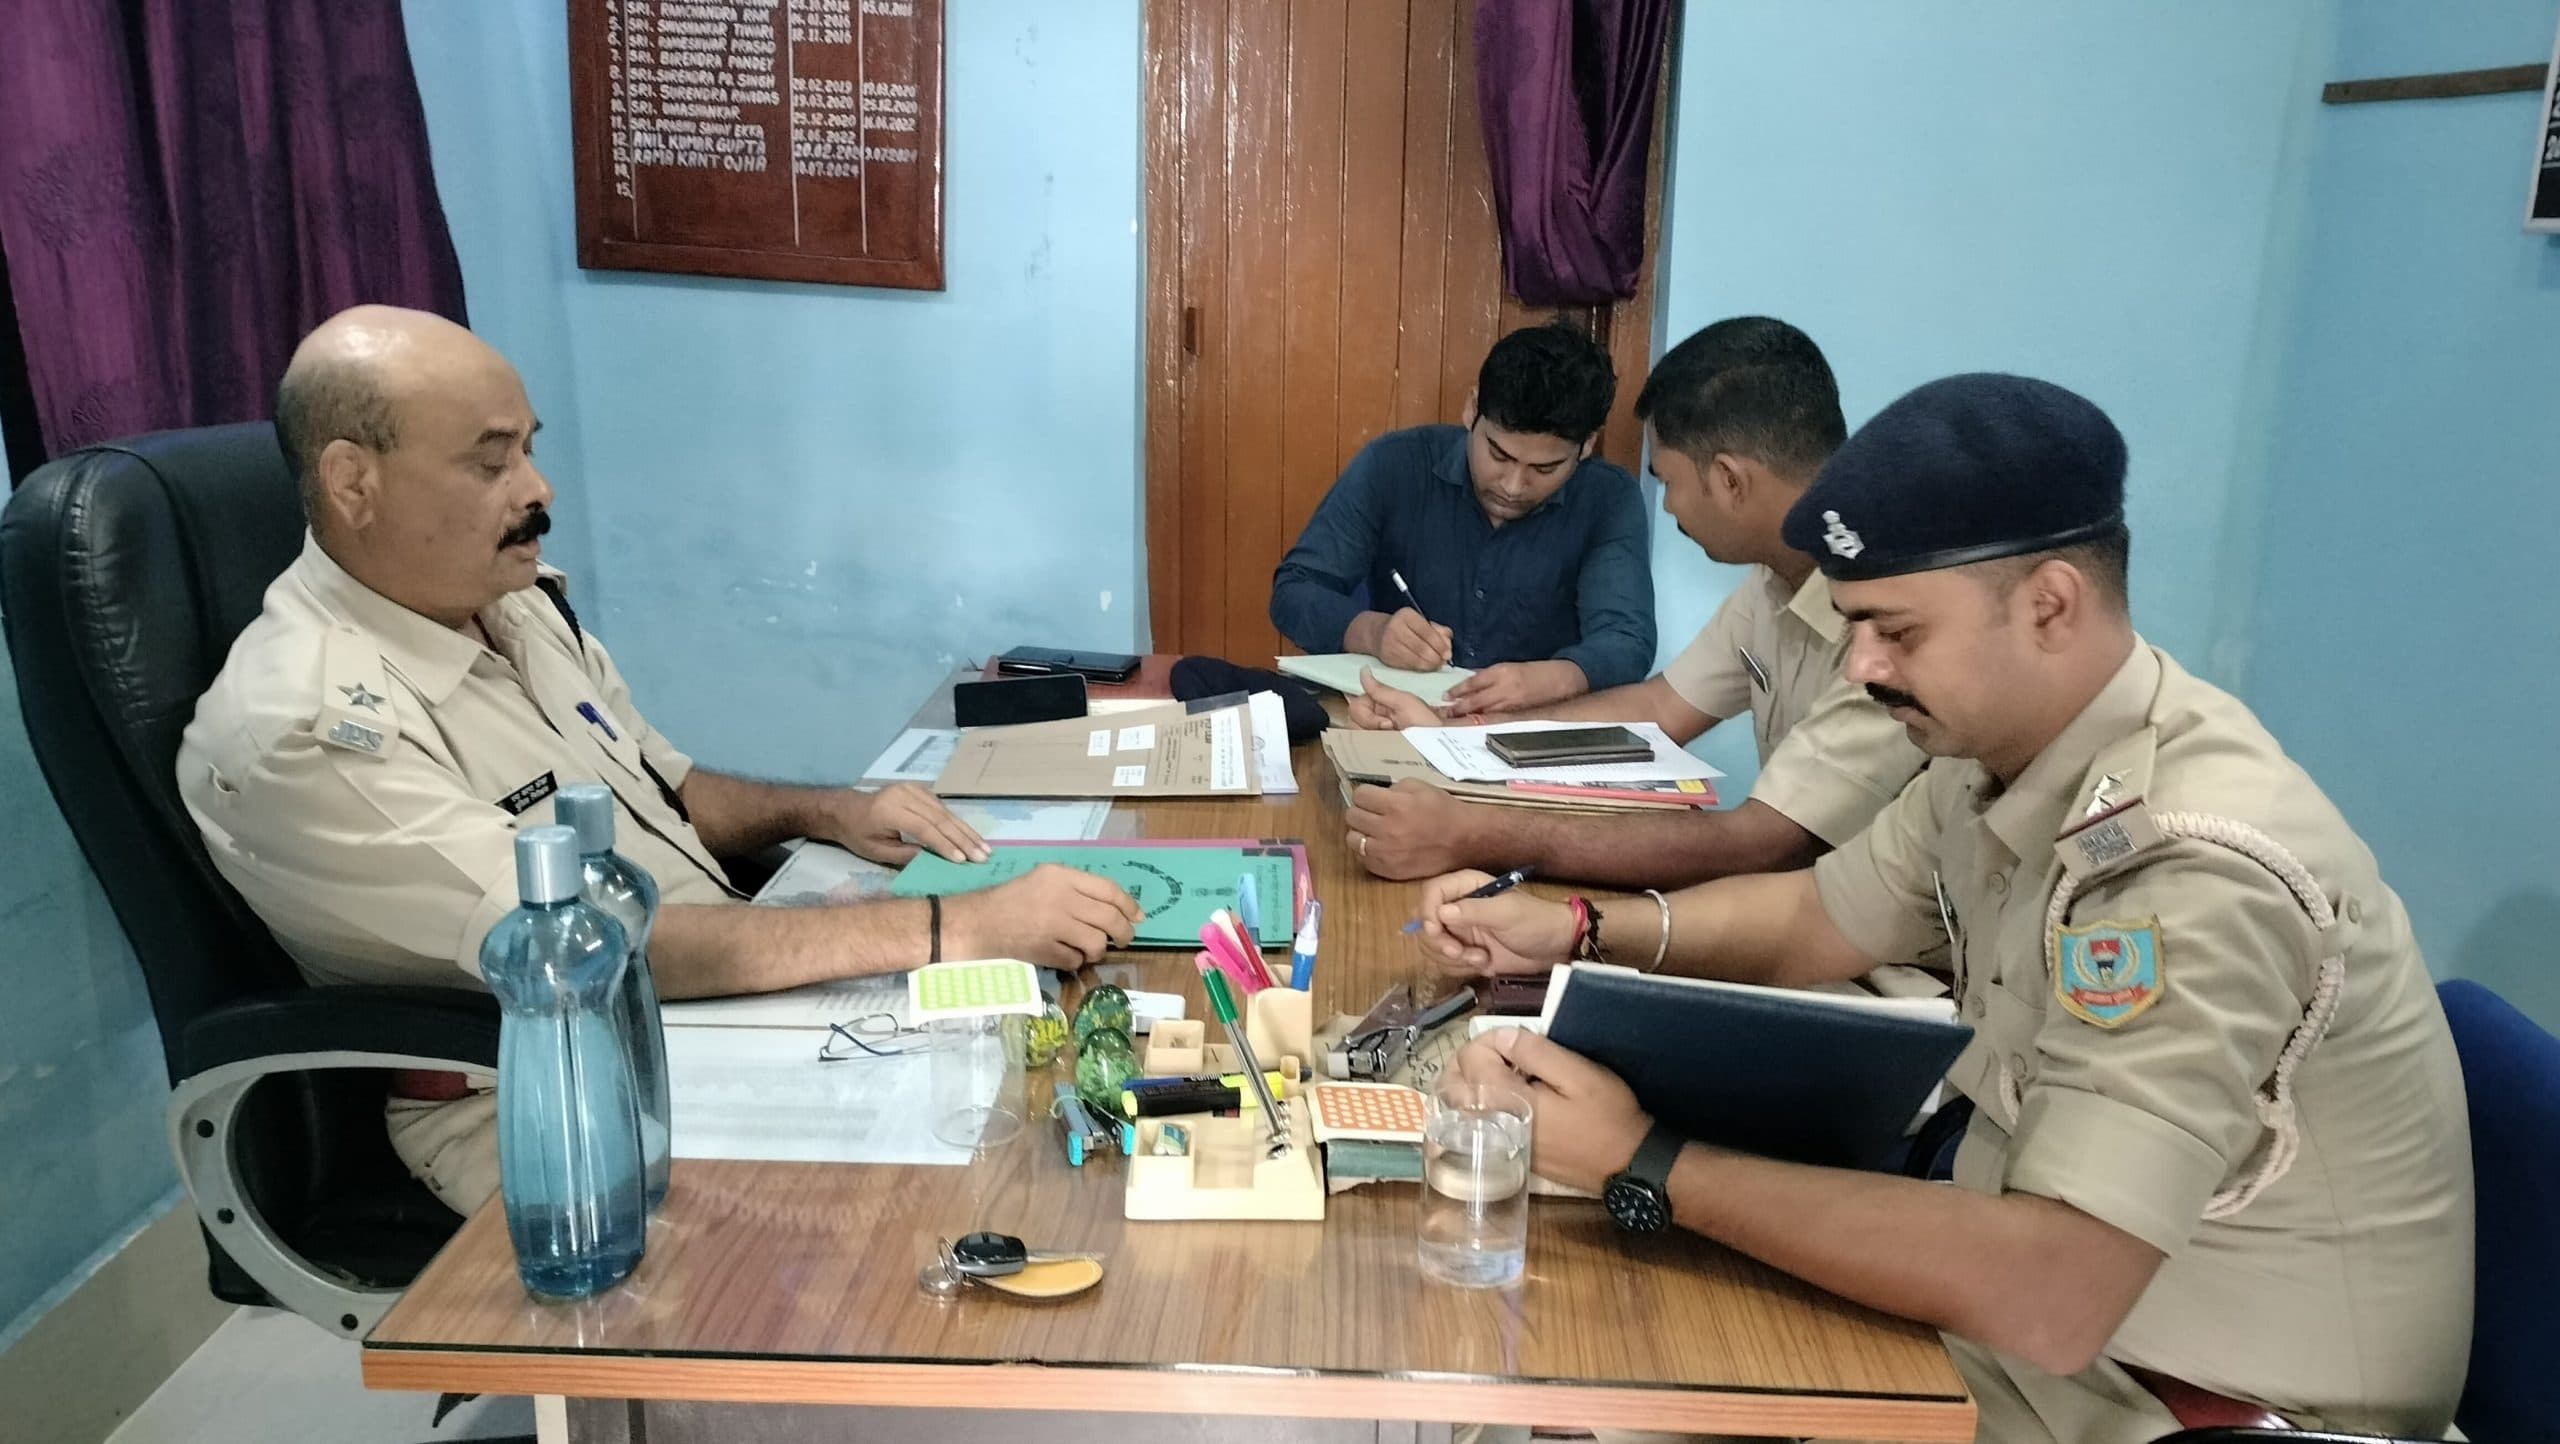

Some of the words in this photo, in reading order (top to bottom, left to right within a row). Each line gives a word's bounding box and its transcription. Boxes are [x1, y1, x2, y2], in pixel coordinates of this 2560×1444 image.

[728, 55, 775, 72] PANDEY
[659, 84, 728, 103] SURENDRA
[633, 131, 666, 149] ANIL
[669, 134, 715, 153] KUMAR
[715, 137, 767, 155] GUPTA
[634, 148, 674, 167] RAMA
[677, 151, 720, 169] KANT
[723, 154, 768, 173] OJHA
